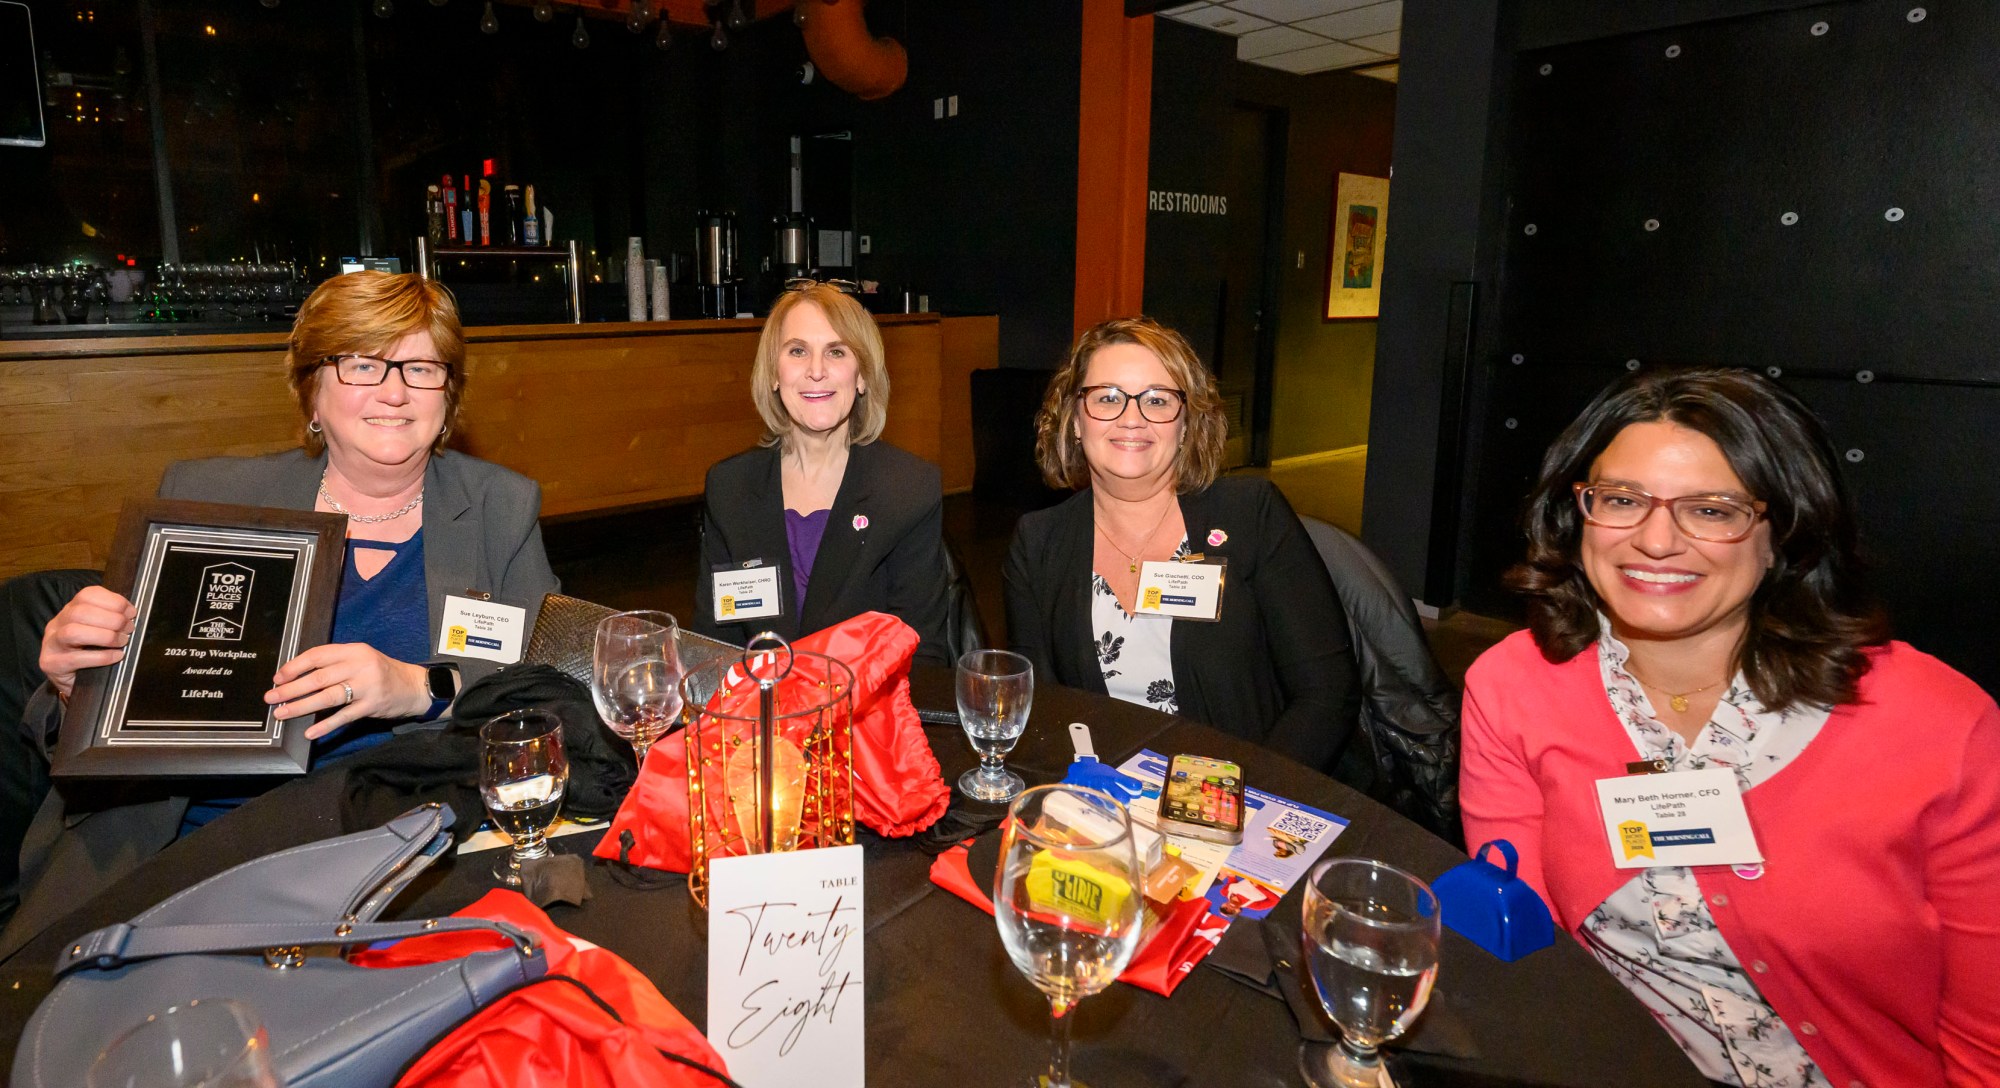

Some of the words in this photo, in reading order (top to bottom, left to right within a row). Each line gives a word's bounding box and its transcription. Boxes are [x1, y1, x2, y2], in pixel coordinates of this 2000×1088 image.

[1150, 191, 1226, 215] RESTROOMS
[211, 573, 246, 585] TOP
[209, 584, 243, 593] WORK
[206, 592, 242, 601] PLACES
[209, 602, 234, 610] 2026
[472, 612, 495, 621] Leyburn,
[164, 648, 187, 656] 2026
[189, 649, 207, 658] Top
[209, 650, 257, 659] Workplace
[182, 667, 222, 675] Awarded
[223, 668, 233, 676] to
[181, 690, 224, 699] LifePath
[1614, 796, 1635, 805] Mary
[1638, 793, 1659, 802] Beth
[1662, 790, 1697, 800] Horner,
[1699, 788, 1720, 797] CFO
[1651, 802, 1686, 811] LifePath
[820, 877, 858, 889] TABLE
[725, 896, 857, 976] Twenty
[727, 971, 862, 1057] Eight
